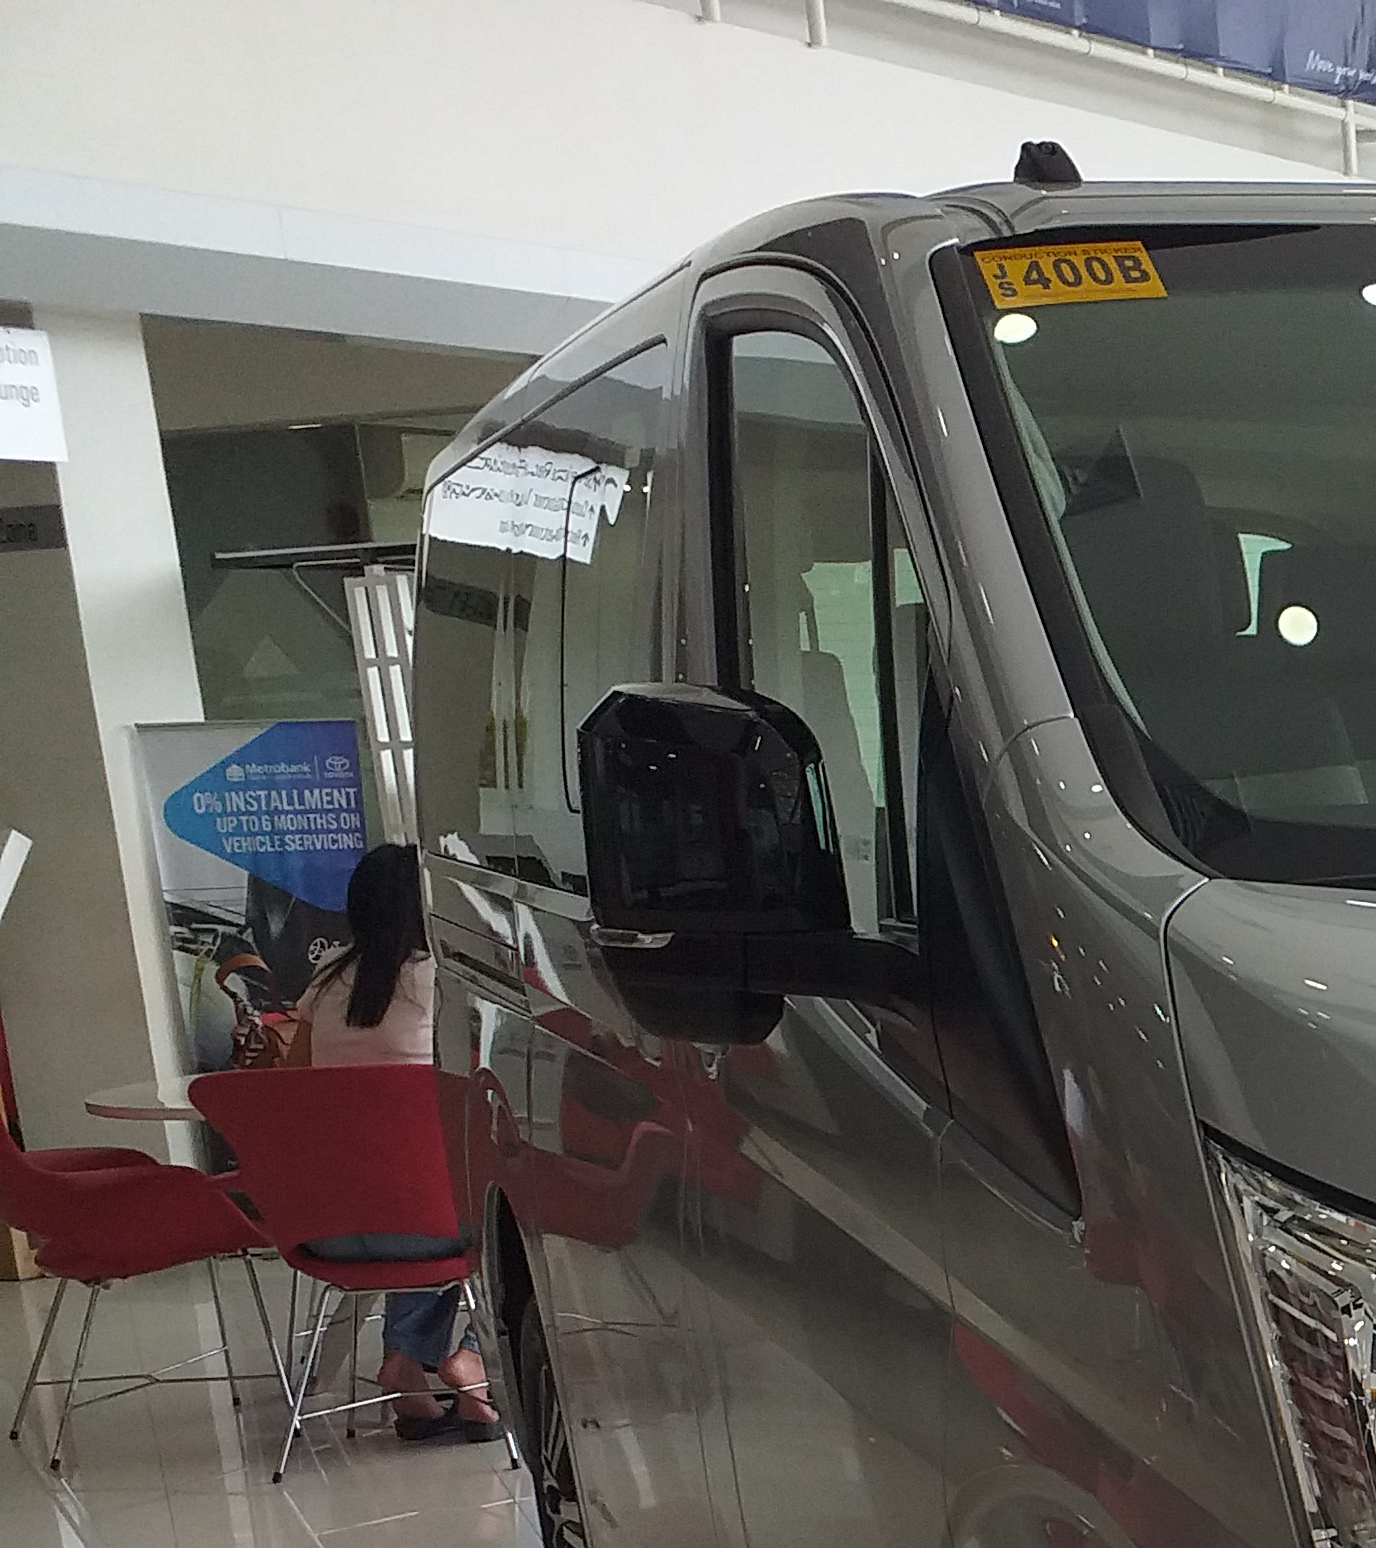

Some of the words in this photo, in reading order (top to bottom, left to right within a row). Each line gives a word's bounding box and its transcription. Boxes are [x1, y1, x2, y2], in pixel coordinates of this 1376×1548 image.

[992, 262, 1008, 280] J
[1022, 254, 1152, 290] 400B
[998, 281, 1018, 298] S
[245, 761, 312, 774] Metrobank
[192, 791, 223, 814] 0%
[225, 788, 358, 812] INSTALLMENT
[216, 817, 238, 833] UP
[241, 816, 259, 832] TO
[261, 815, 272, 831] 6
[274, 814, 338, 831] MONTHS
[340, 813, 361, 829] ON
[222, 834, 282, 853] VEHICLE
[284, 833, 364, 851] SERVICING
